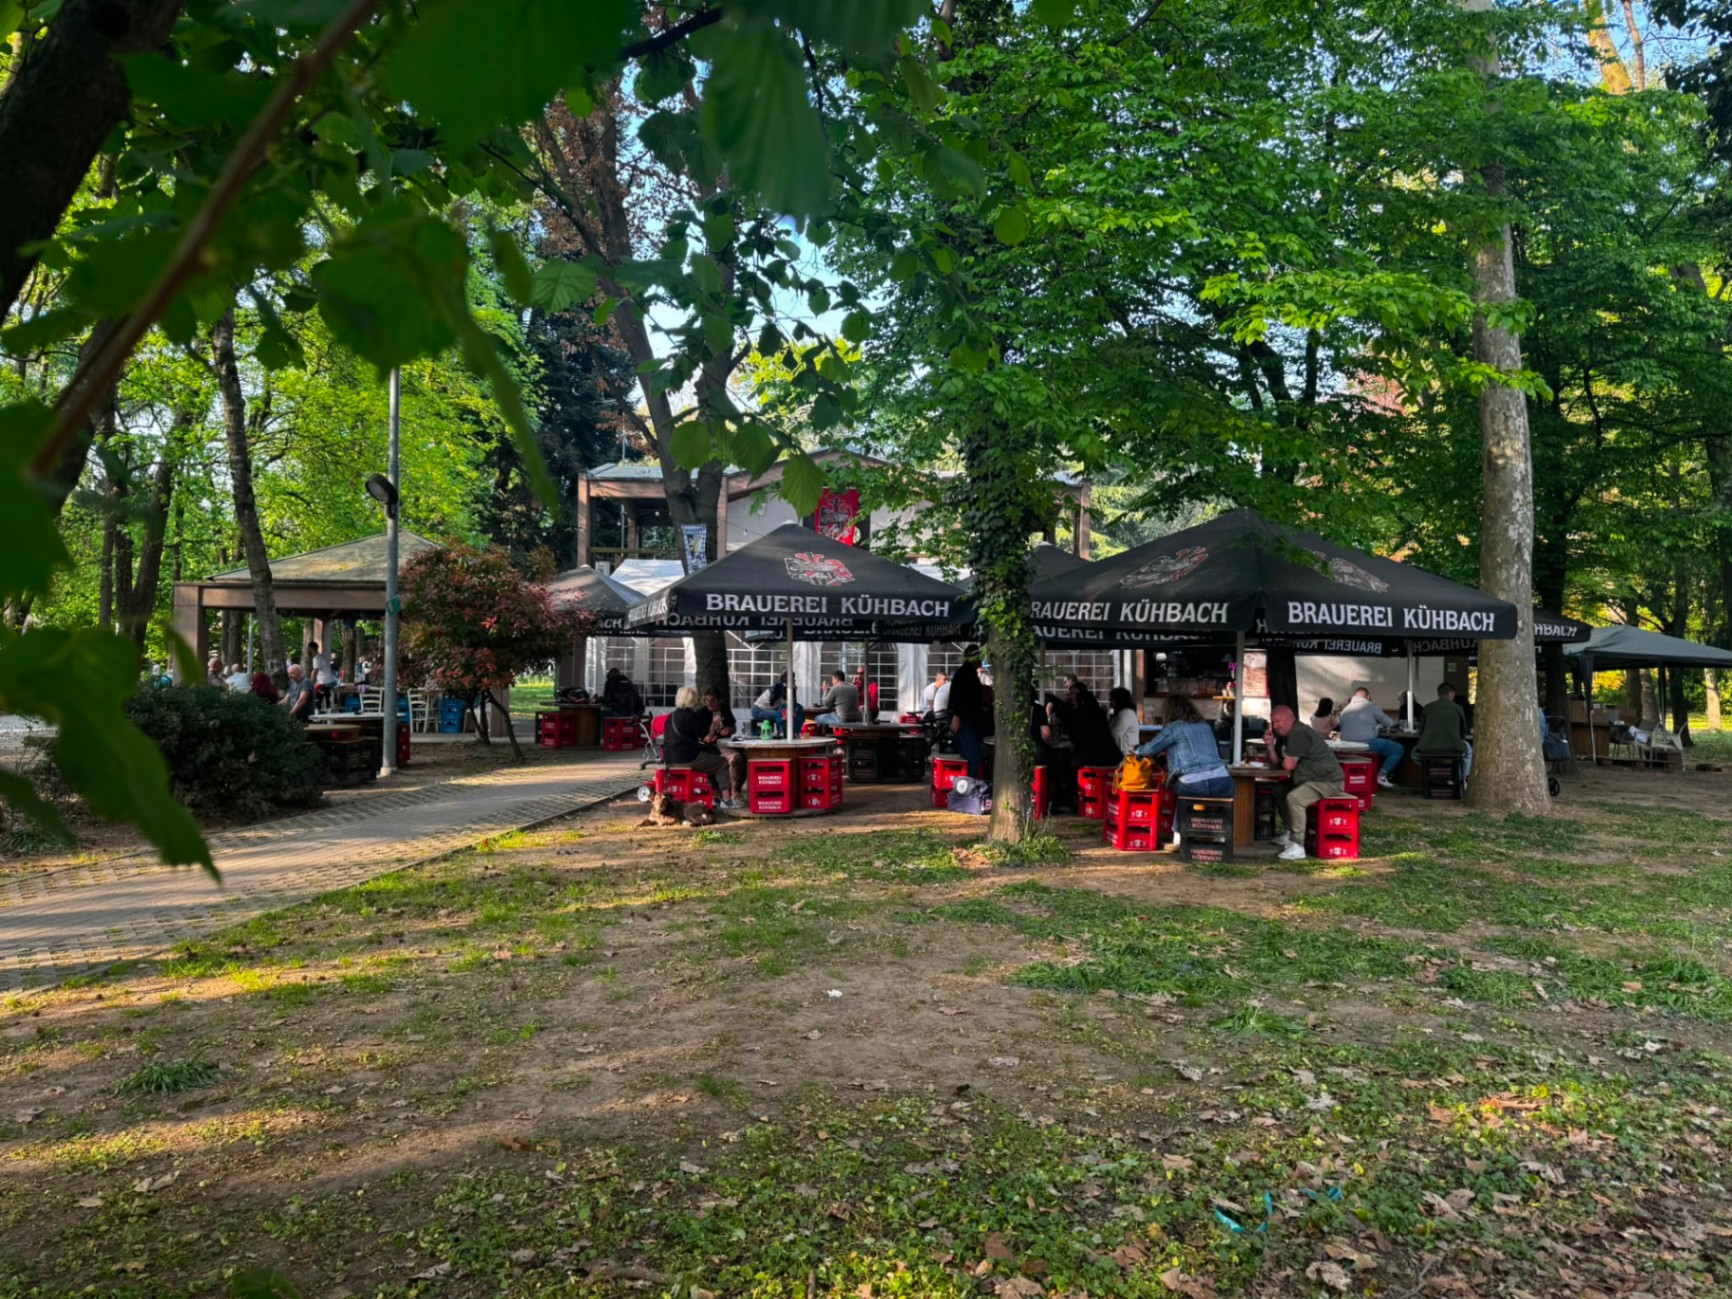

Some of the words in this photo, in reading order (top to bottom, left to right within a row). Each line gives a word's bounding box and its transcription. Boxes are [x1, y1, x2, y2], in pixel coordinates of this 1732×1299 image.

[706, 593, 827, 614] BRAUEREI
[841, 594, 950, 617] KÜHBACH
[1030, 601, 1111, 621] RAUEREI
[1119, 598, 1229, 623] KÜHBACH
[1287, 601, 1393, 627] BRAUEREI
[1403, 605, 1495, 632] KÜHBACH
[1534, 623, 1578, 637] HBACH
